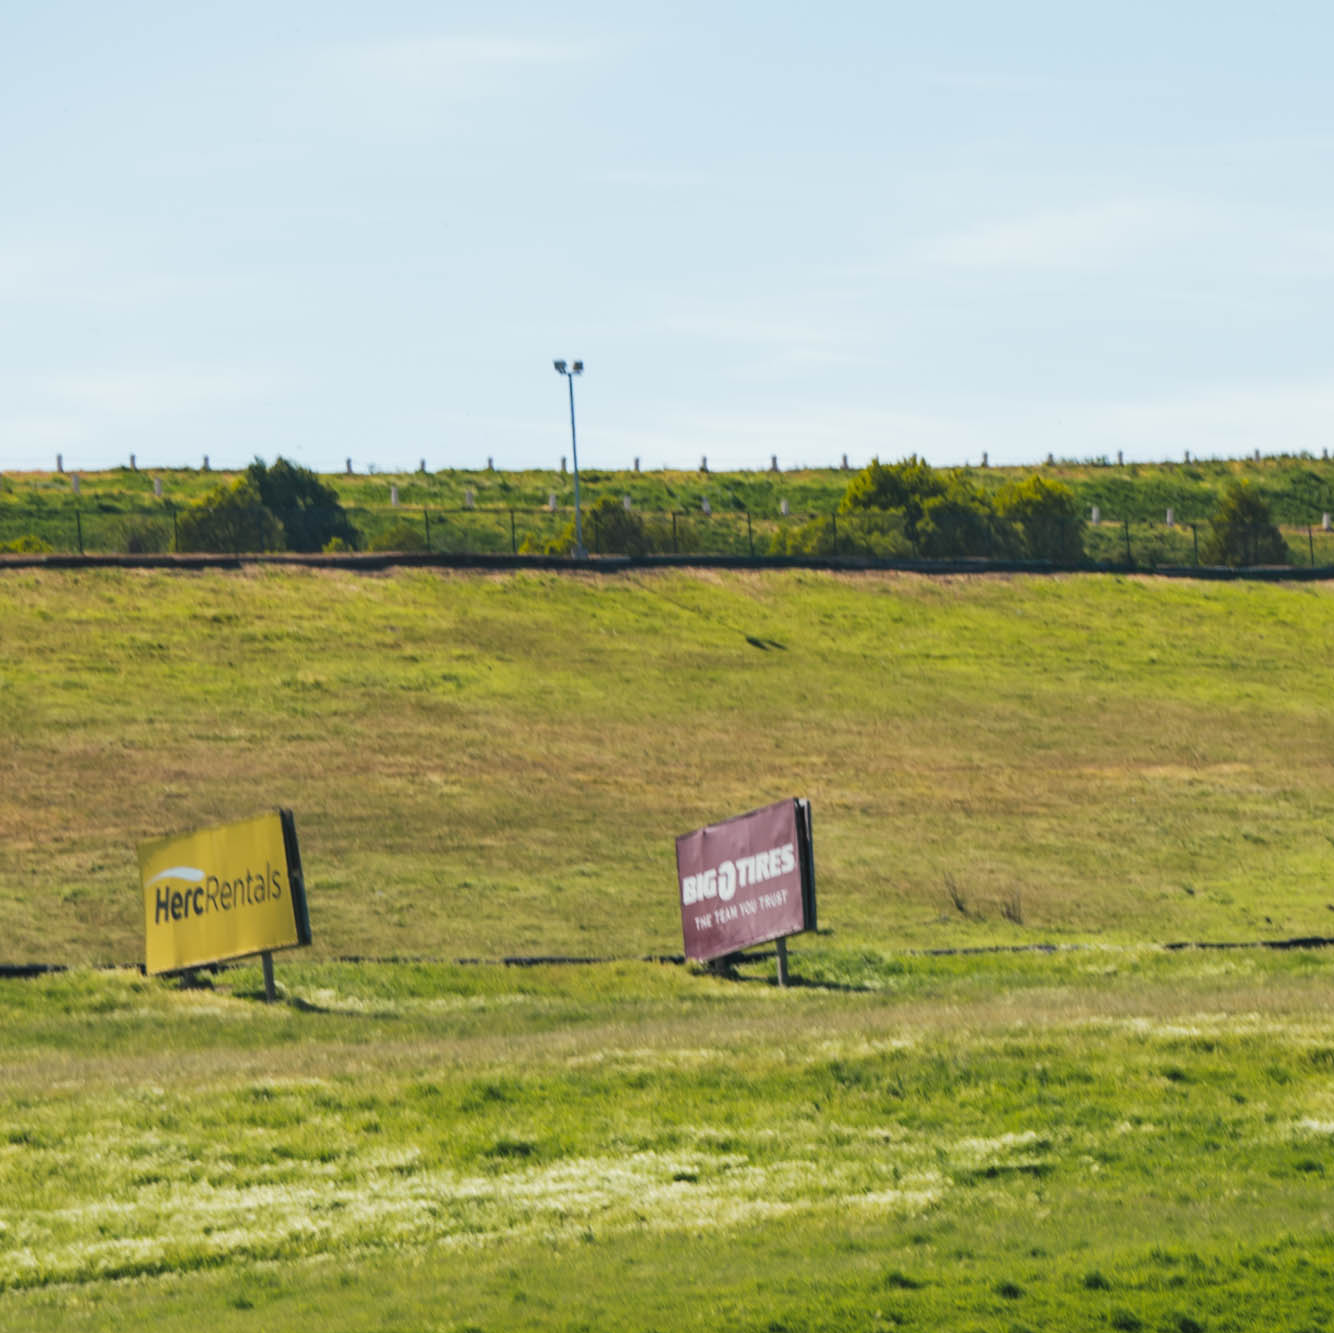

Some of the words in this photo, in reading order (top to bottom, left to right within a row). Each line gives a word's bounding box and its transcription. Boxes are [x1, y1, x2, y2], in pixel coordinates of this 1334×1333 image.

[682, 868, 717, 906] BIG
[718, 859, 737, 902] O
[736, 842, 796, 888] TIRES
[714, 904, 739, 925] TEAM
[739, 898, 758, 920] YOU
[758, 888, 789, 911] TRUST
